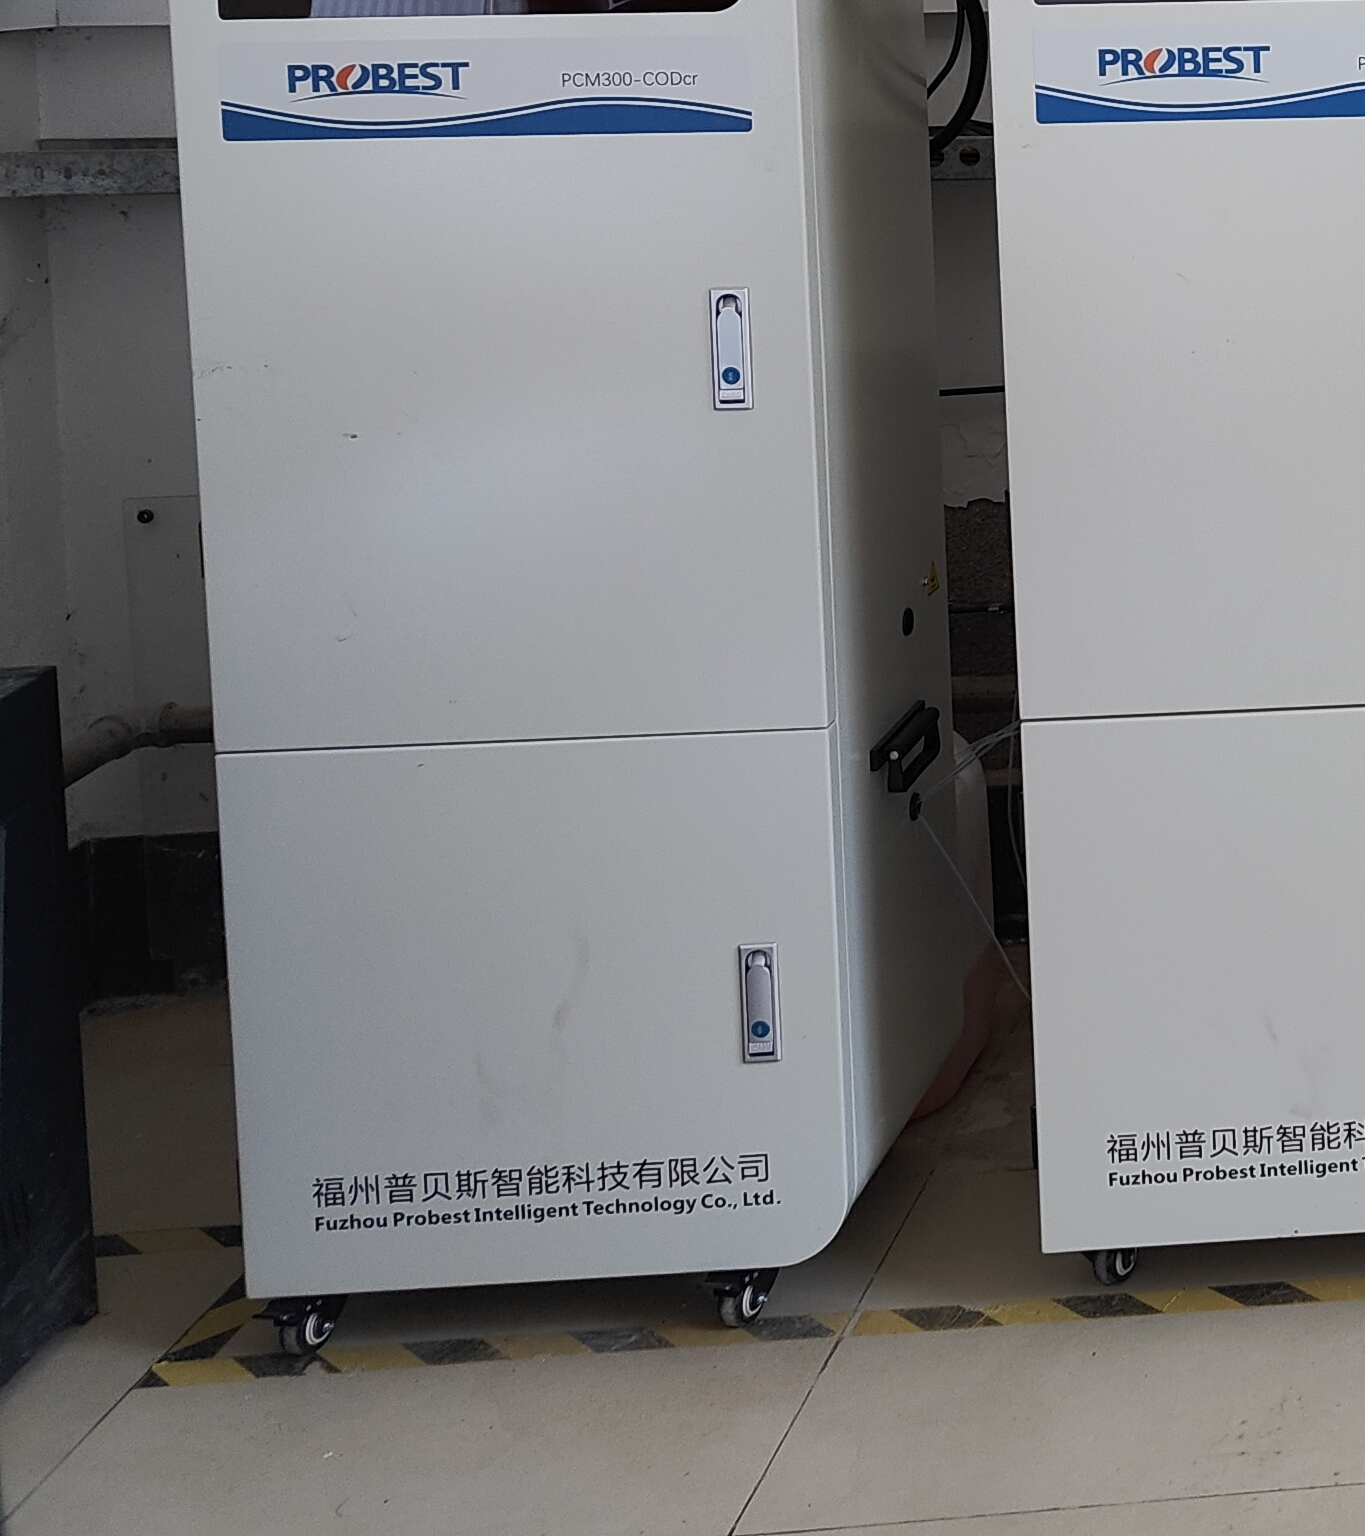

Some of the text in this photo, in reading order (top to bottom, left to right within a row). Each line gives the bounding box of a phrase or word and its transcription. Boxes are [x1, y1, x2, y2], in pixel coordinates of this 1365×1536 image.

[1098, 46, 1270, 77] PROBEST
[287, 62, 469, 93] PROBEST
[560, 71, 699, 88] PCM300-CODcr
[312, 1154, 768, 1208] 福州普贝斯智能科技有限公司
[1109, 1170, 1177, 1186] Fuzhou
[1183, 1165, 1256, 1182] Probest
[1260, 1159, 1358, 1178] Intelligent
[315, 1190, 781, 1232] Fuzhou Probest Intelligent Technology Co., Ltd.
